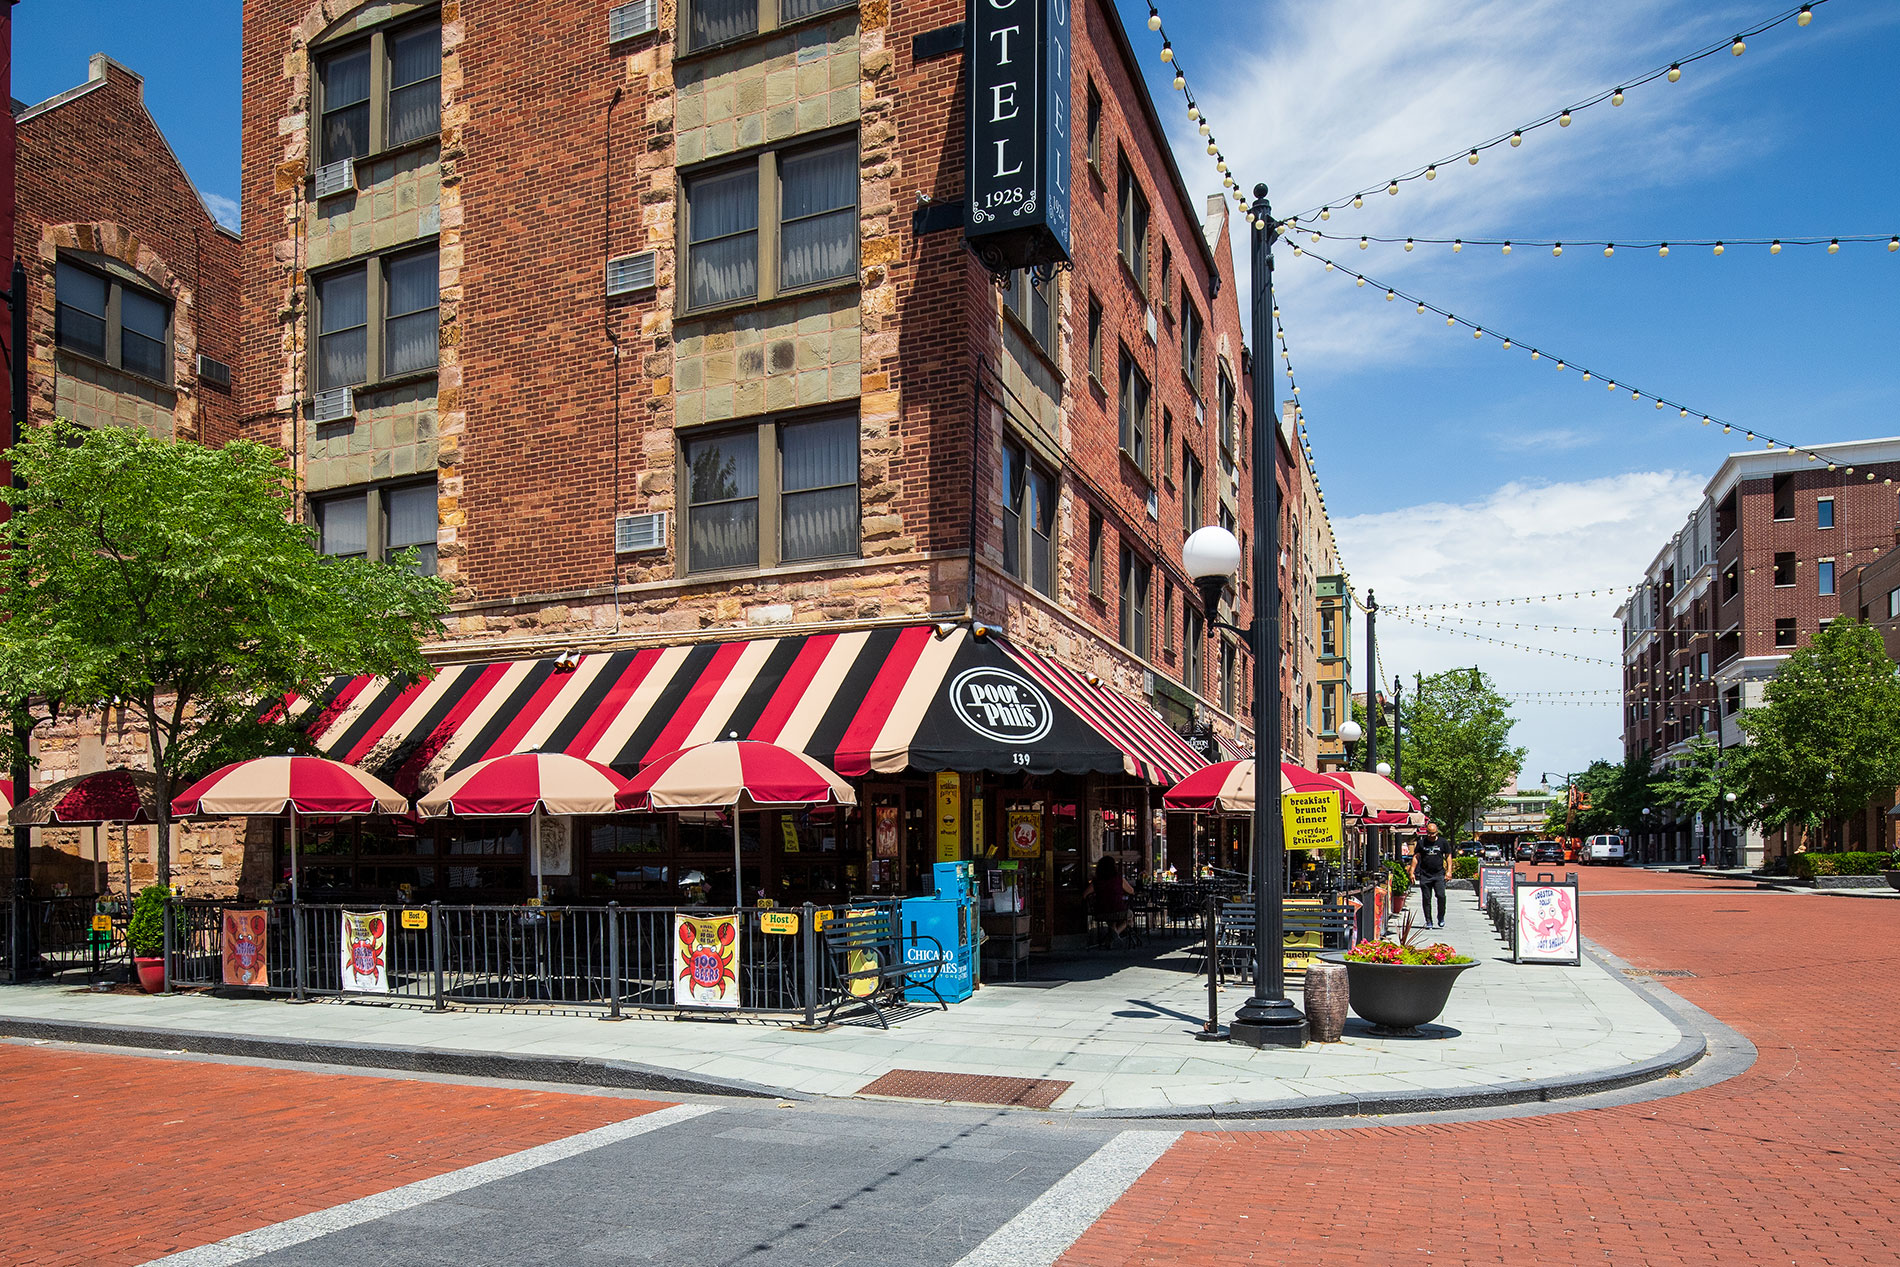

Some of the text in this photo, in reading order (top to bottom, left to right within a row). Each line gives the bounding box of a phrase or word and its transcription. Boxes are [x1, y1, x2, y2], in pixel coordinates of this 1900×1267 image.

[988, 0, 1024, 178] TEL
[985, 187, 1024, 209] 1928
[1052, 196, 1066, 224] 1928
[968, 683, 1020, 705] Poor
[1012, 753, 1031, 767] 139
[1290, 796, 1331, 806] breakfast
[1295, 805, 1327, 815] brunch
[1296, 815, 1327, 824] dinner
[1296, 827, 1329, 836] everyday!
[1293, 835, 1334, 846] grillroom
[1534, 889, 1554, 900] LOBSTER
[769, 914, 789, 924] Host
[694, 954, 718, 968] 100
[694, 967, 720, 983] BEERS
